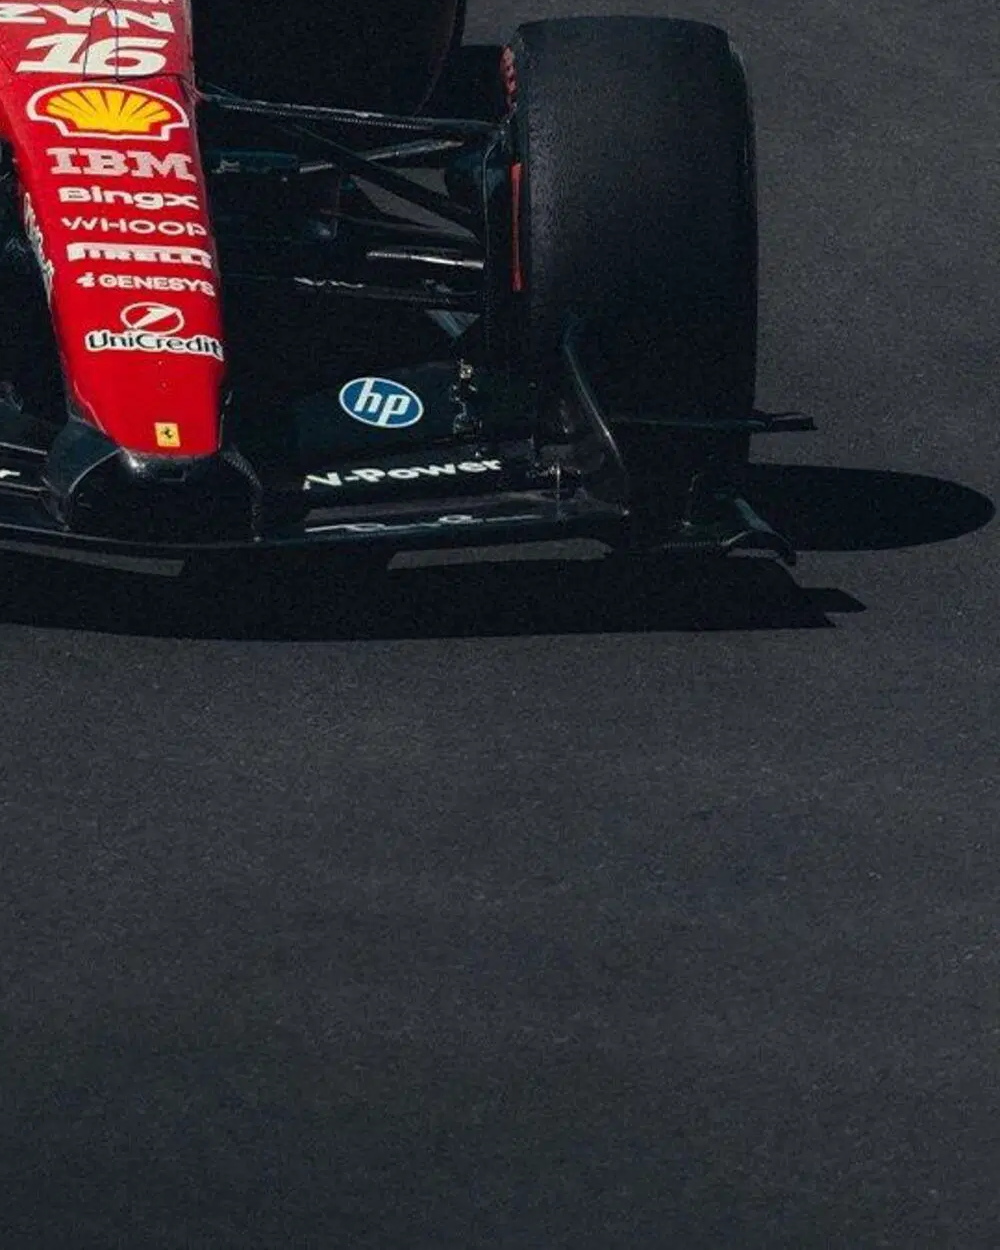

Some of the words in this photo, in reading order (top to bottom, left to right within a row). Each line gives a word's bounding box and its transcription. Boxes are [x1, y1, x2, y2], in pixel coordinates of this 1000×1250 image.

[15, 32, 169, 77] 16
[46, 147, 197, 183] IBM
[61, 216, 208, 236] WHOOP
[99, 273, 216, 297] GENESYS
[86, 329, 224, 362] UniCredit
[353, 376, 411, 428] hp
[302, 459, 502, 491] V-Power
